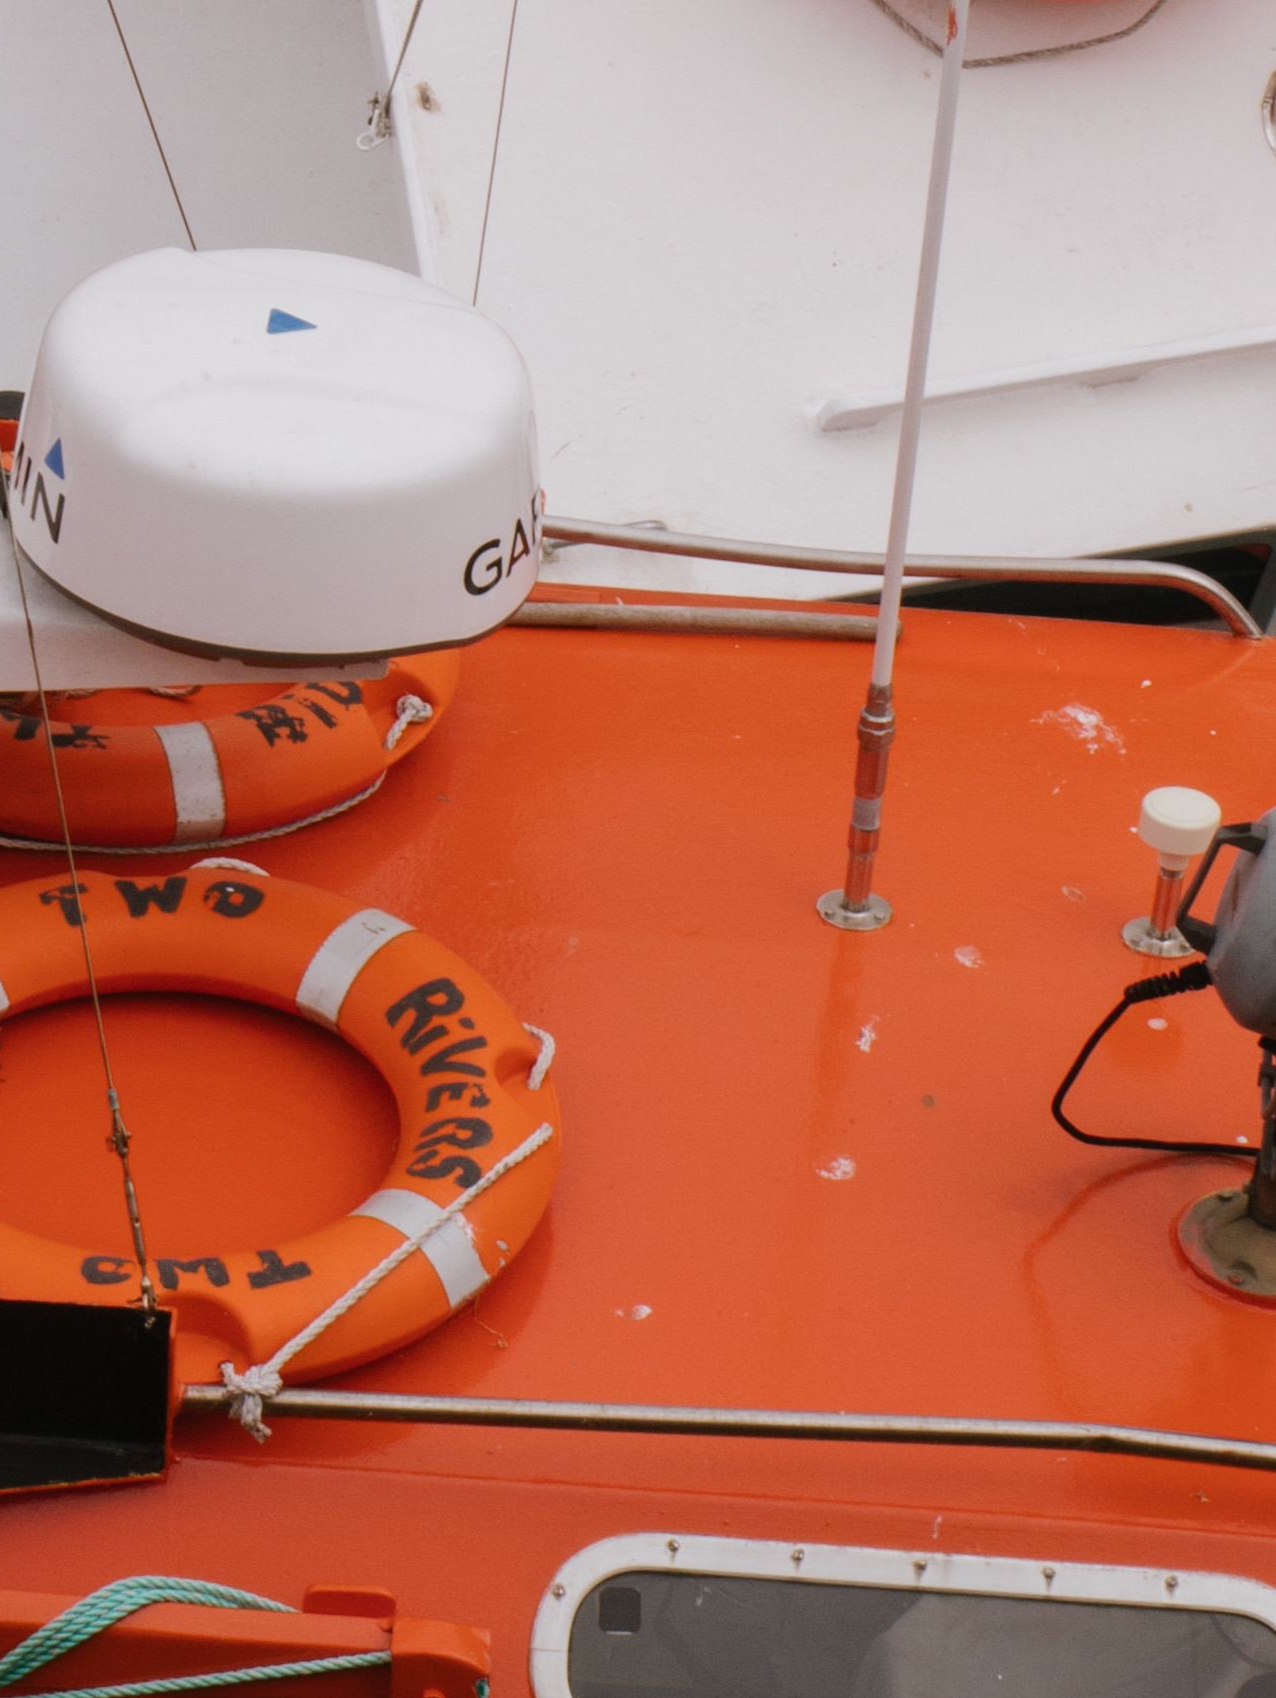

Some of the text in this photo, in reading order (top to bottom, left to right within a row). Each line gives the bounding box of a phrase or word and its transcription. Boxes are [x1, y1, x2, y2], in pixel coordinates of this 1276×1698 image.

[13, 440, 66, 545] IN
[39, 874, 267, 928] TWO
[80, 1248, 313, 1291] TWO
